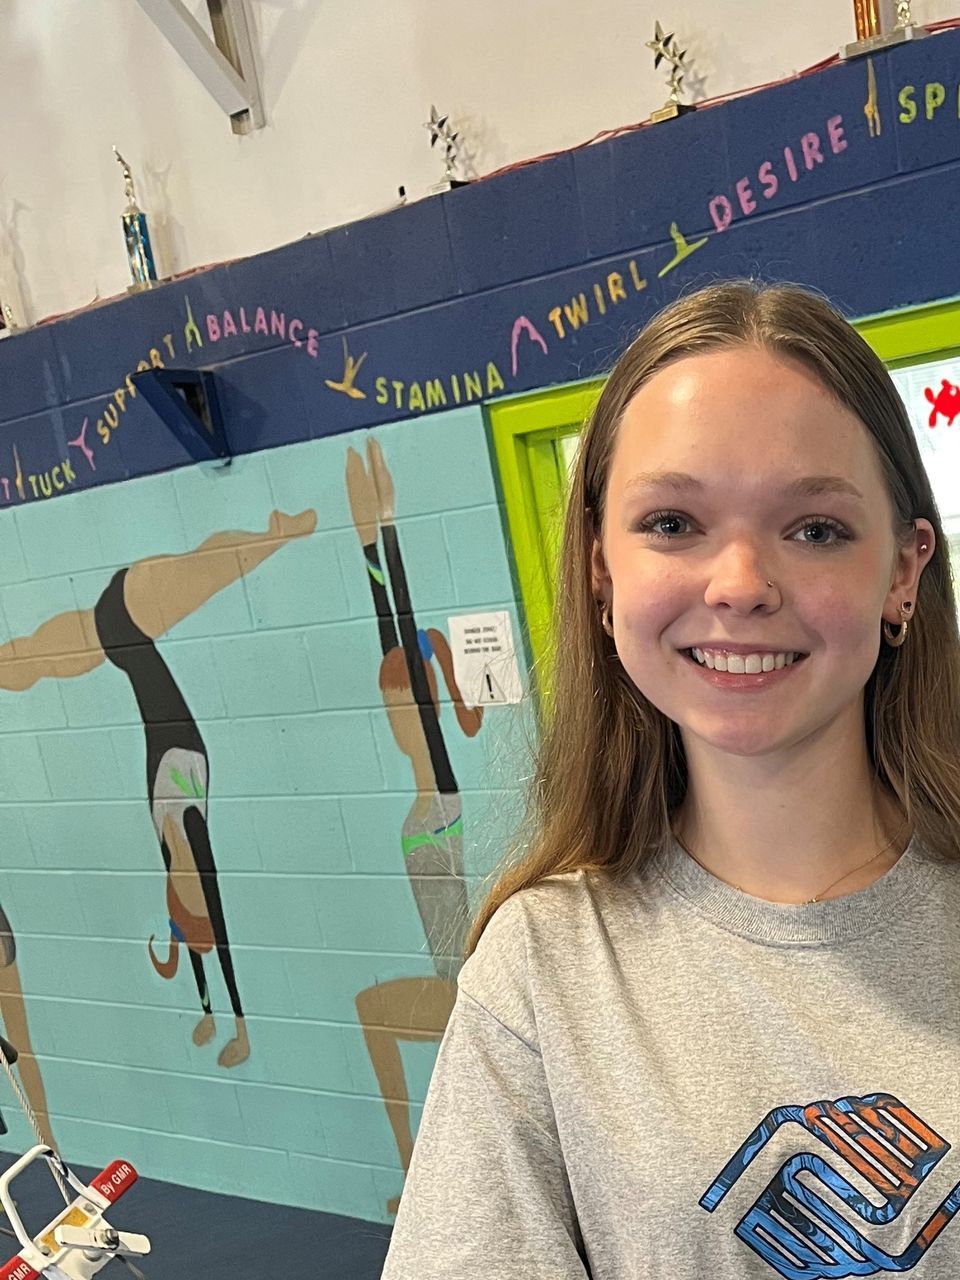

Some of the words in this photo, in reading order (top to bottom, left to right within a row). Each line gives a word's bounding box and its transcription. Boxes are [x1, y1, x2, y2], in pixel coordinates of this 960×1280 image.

[28, 457, 76, 498] TUCK
[206, 307, 319, 358] BALANCE
[375, 362, 504, 413] STAMINA
[548, 260, 648, 340] TWIRL
[708, 114, 848, 233] DESIRE
[100, 1181, 117, 1196] By
[111, 1163, 132, 1185] GMR
